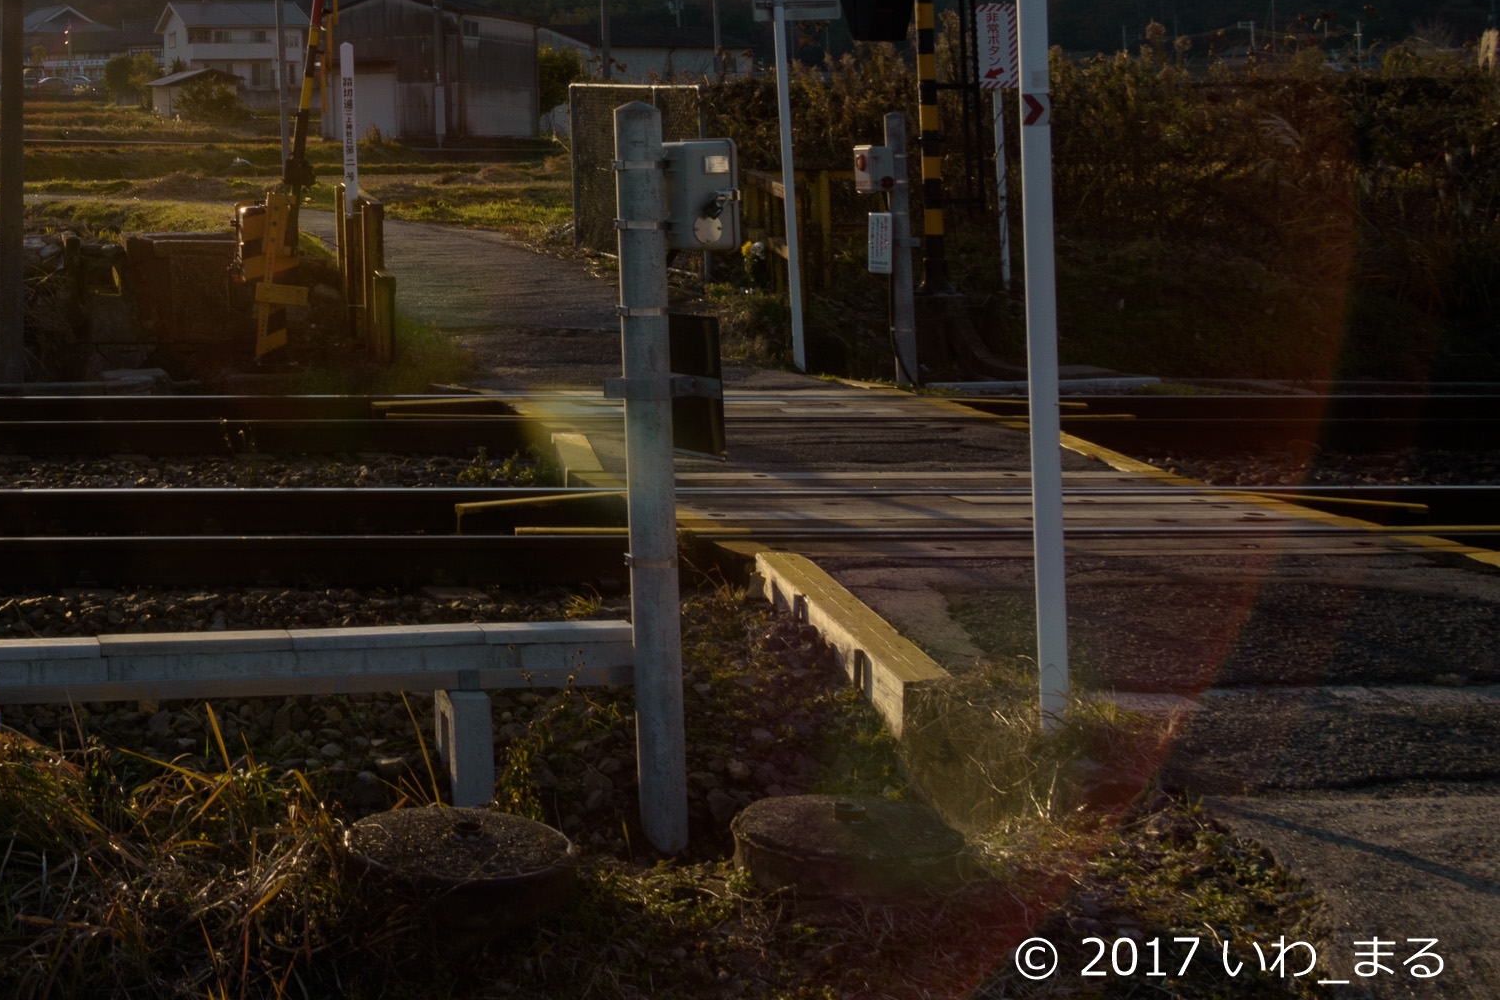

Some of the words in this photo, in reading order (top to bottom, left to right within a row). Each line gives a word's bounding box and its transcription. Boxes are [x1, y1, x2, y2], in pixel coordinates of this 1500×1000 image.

[985, 11, 1001, 67] 非常ボタン
